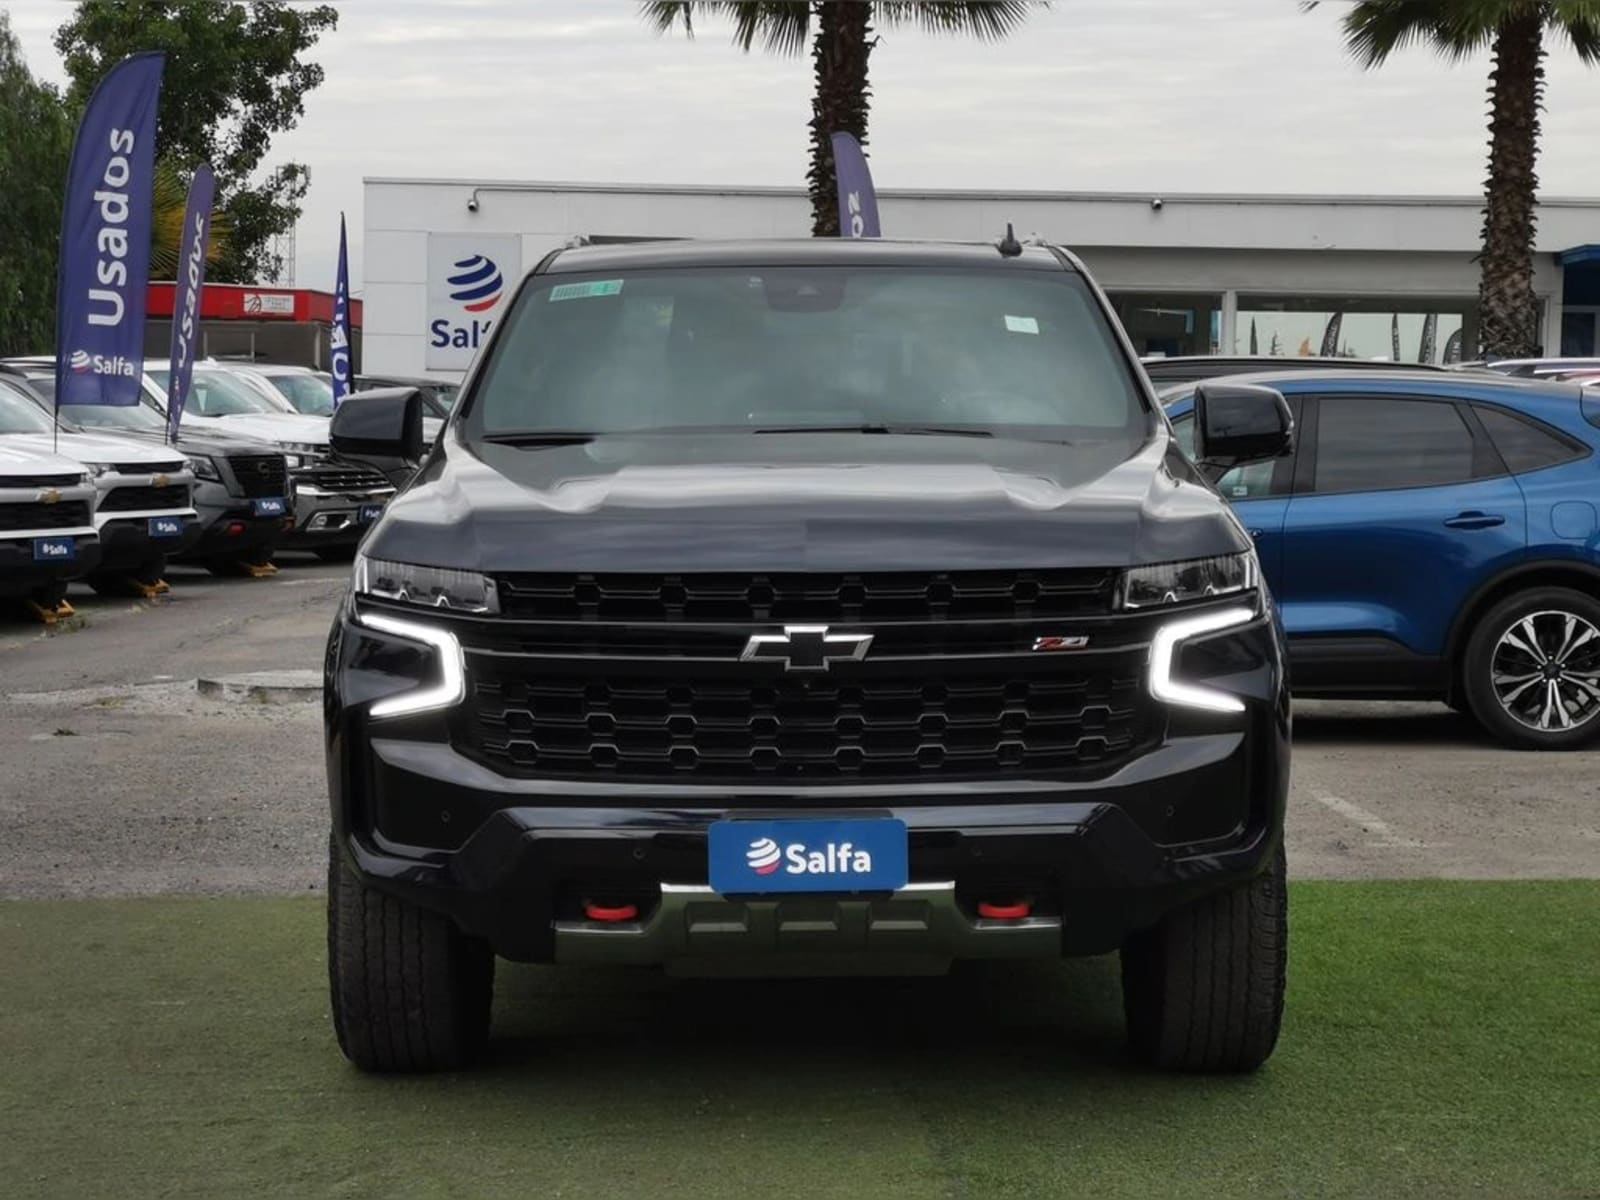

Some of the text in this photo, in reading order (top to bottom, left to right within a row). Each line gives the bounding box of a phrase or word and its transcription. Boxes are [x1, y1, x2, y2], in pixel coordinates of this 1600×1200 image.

[88, 128, 134, 326] Usados
[93, 355, 135, 377] Salfa
[785, 842, 872, 874] Salfa
